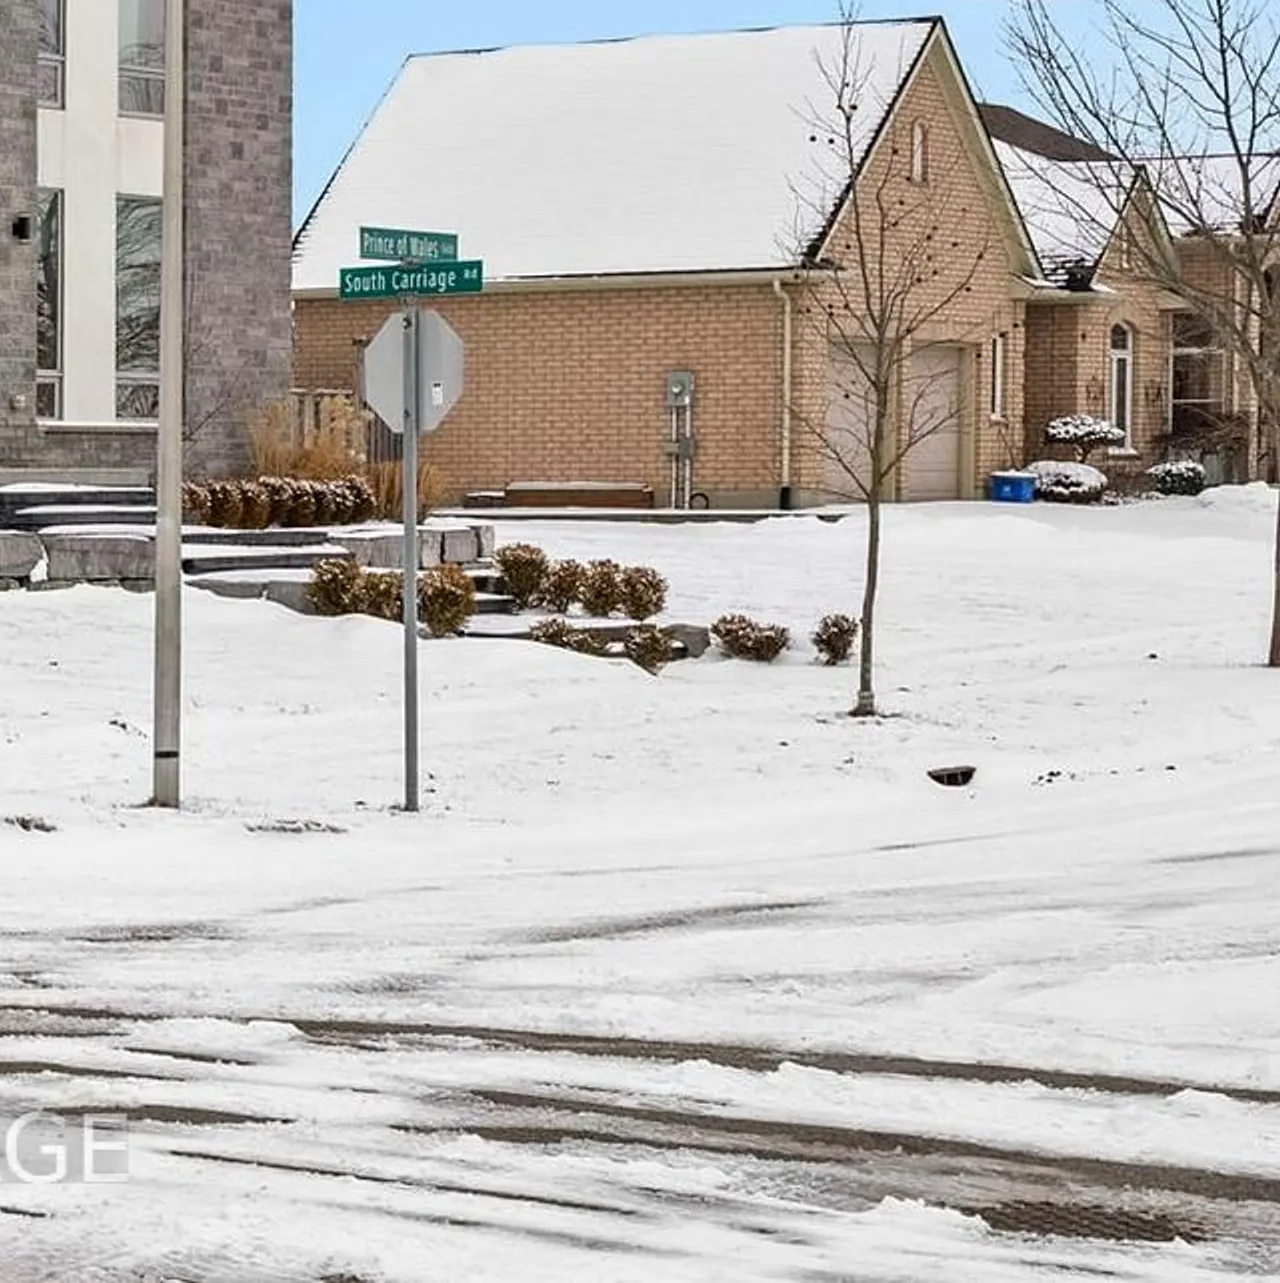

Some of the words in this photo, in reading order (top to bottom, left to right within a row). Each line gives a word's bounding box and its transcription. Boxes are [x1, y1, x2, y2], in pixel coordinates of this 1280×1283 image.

[363, 233, 395, 254] Prince
[396, 233, 408, 255] of
[409, 236, 439, 258] Wales
[344, 271, 386, 293] South
[392, 269, 457, 293] Carriage
[463, 269, 478, 279] Rd
